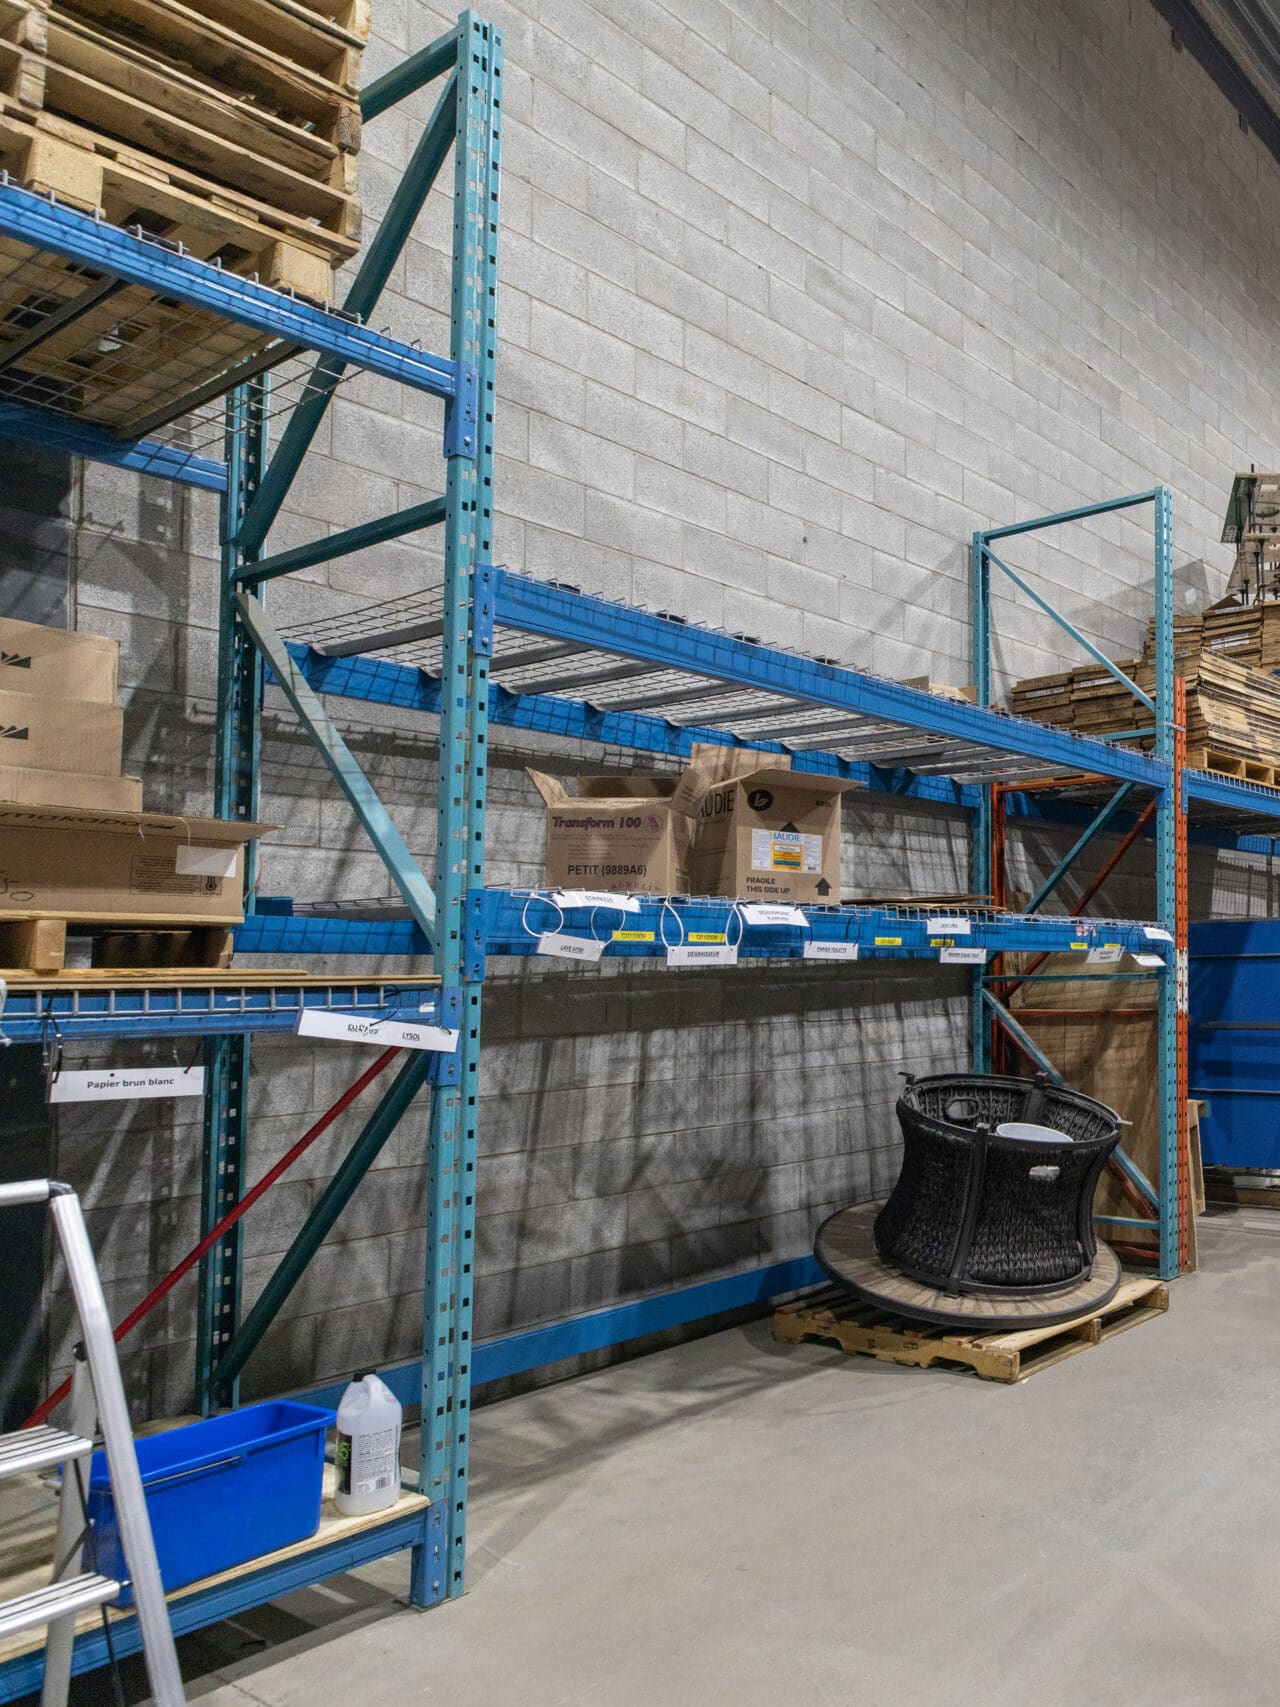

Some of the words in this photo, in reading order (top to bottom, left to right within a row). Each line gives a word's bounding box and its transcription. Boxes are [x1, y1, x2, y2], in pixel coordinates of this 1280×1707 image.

[552, 815, 615, 831] Transform
[619, 816, 642, 829] 100
[773, 832, 801, 842] LAUDIE
[567, 864, 599, 875] PETIT
[601, 864, 647, 877] (9889A6)
[746, 876, 776, 885] FRAGILE
[763, 886, 779, 894] SIDE
[87, 1080, 120, 1089] Papier
[122, 1079, 146, 1088] brun
[148, 1078, 174, 1086] blanc
